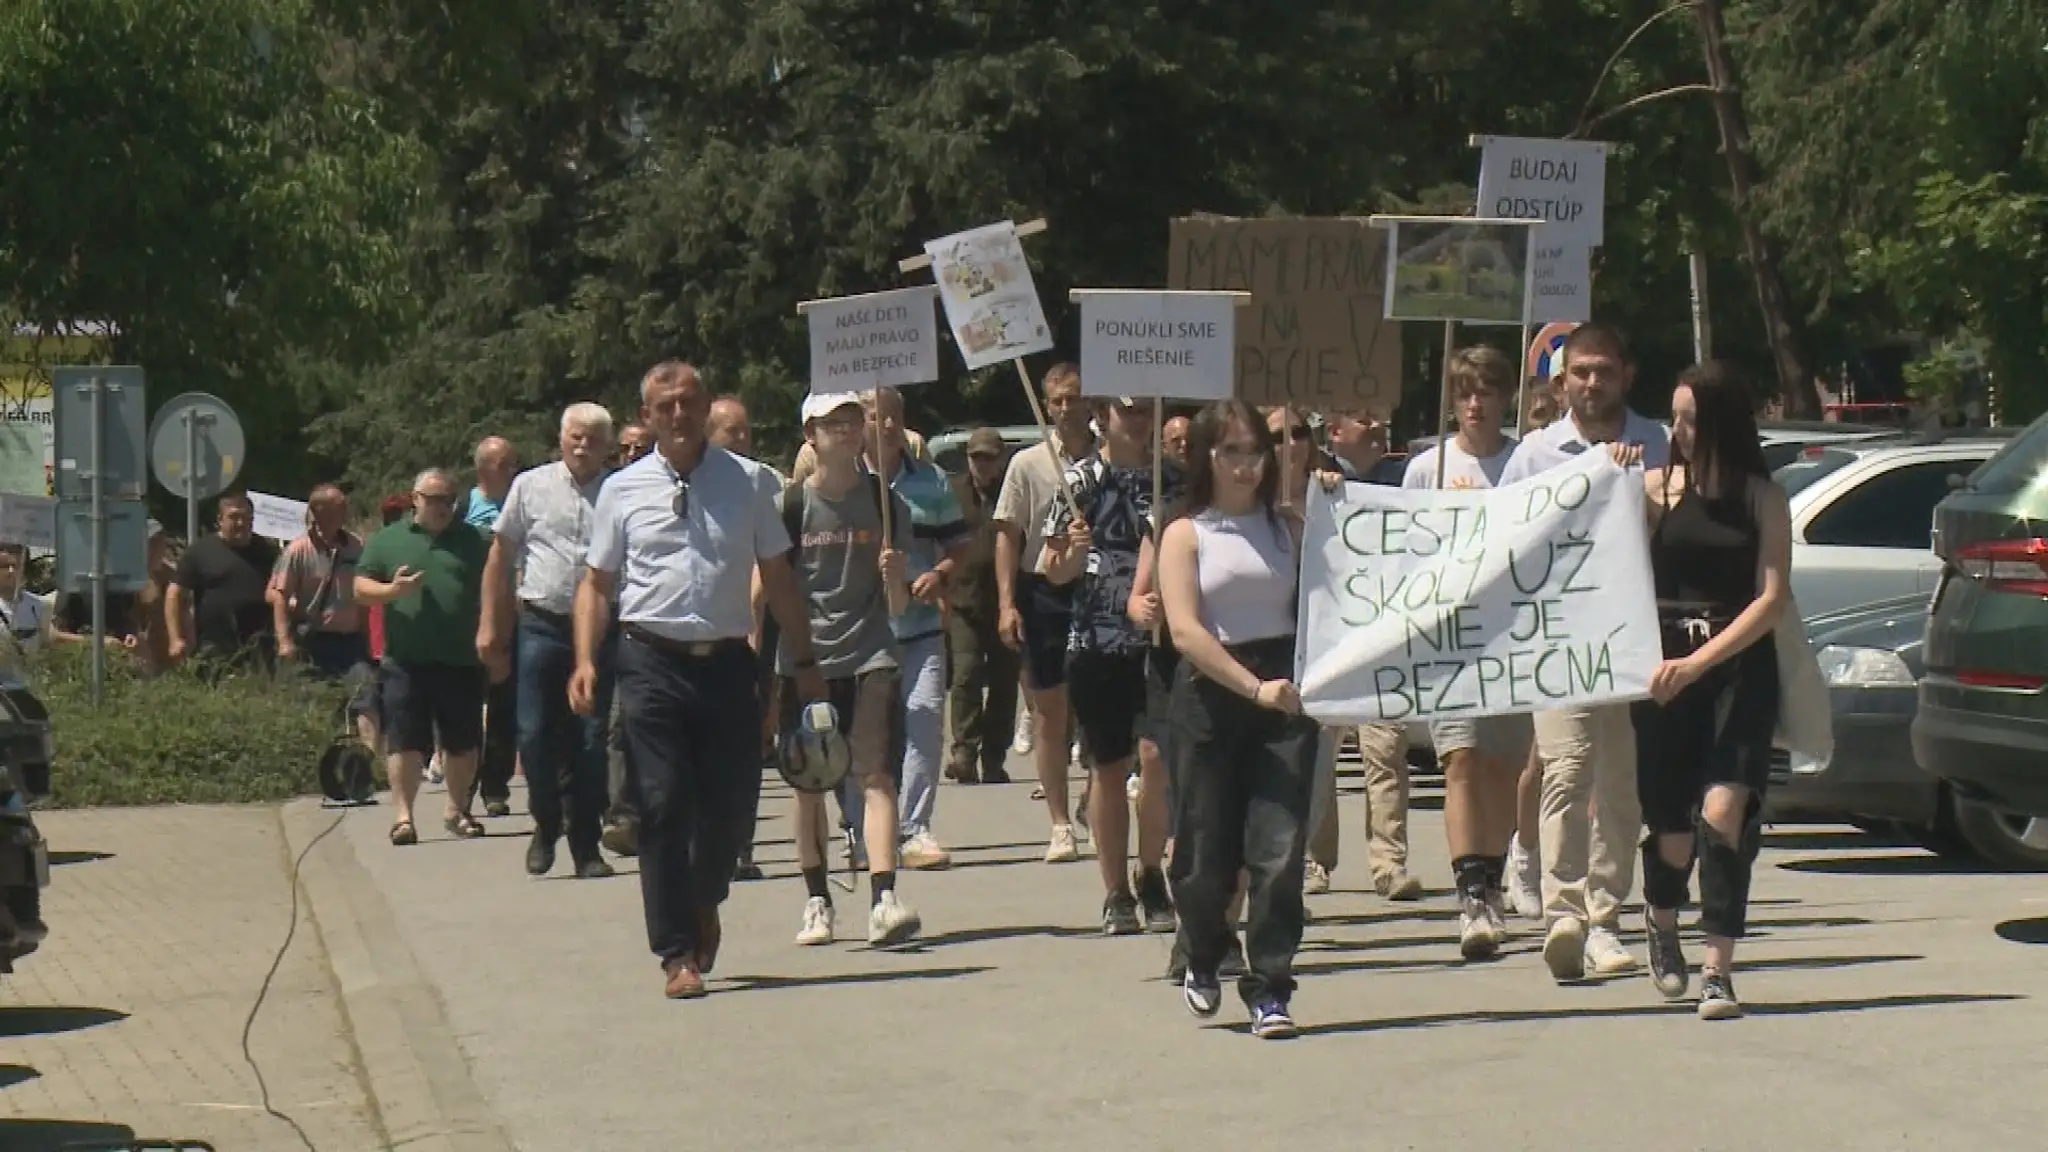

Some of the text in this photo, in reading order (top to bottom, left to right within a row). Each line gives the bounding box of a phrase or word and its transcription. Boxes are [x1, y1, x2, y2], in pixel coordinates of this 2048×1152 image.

[1510, 157, 1577, 183] BUDAJ
[876, 307, 907, 321] DETI
[1096, 318, 1216, 338] PONÚKLI SME
[1261, 300, 1301, 342] NA
[828, 363, 848, 377] NA
[1117, 347, 1195, 366] RIEŠENIE
[1342, 472, 1591, 557] CESTA DO
[1340, 528, 1602, 627] ŠKOLY UŽ
[1405, 600, 1571, 658] NIE JE
[1373, 622, 1628, 720] BEZPEČNÁ
